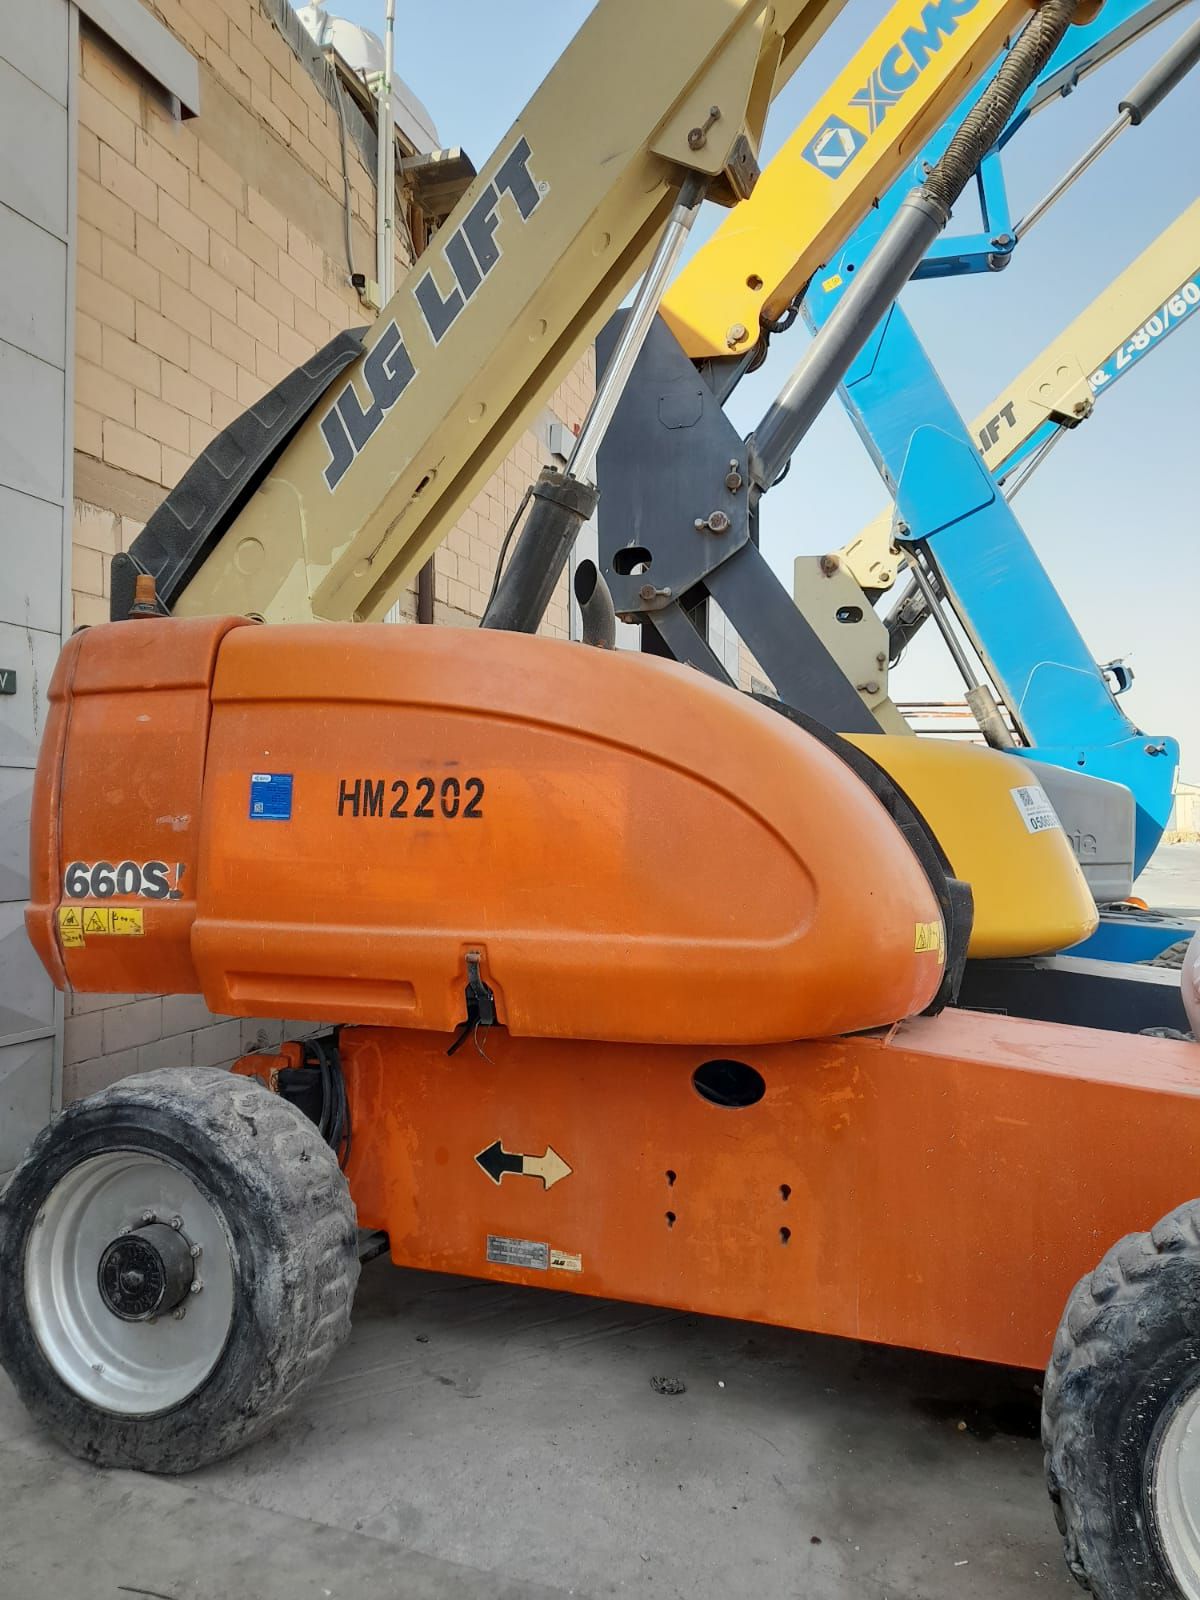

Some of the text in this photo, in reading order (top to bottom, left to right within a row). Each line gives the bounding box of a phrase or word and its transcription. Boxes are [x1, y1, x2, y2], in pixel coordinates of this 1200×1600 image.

[319, 135, 540, 492] JLG LIFT
[979, 401, 1017, 455] IFT
[338, 777, 485, 818] HM2202
